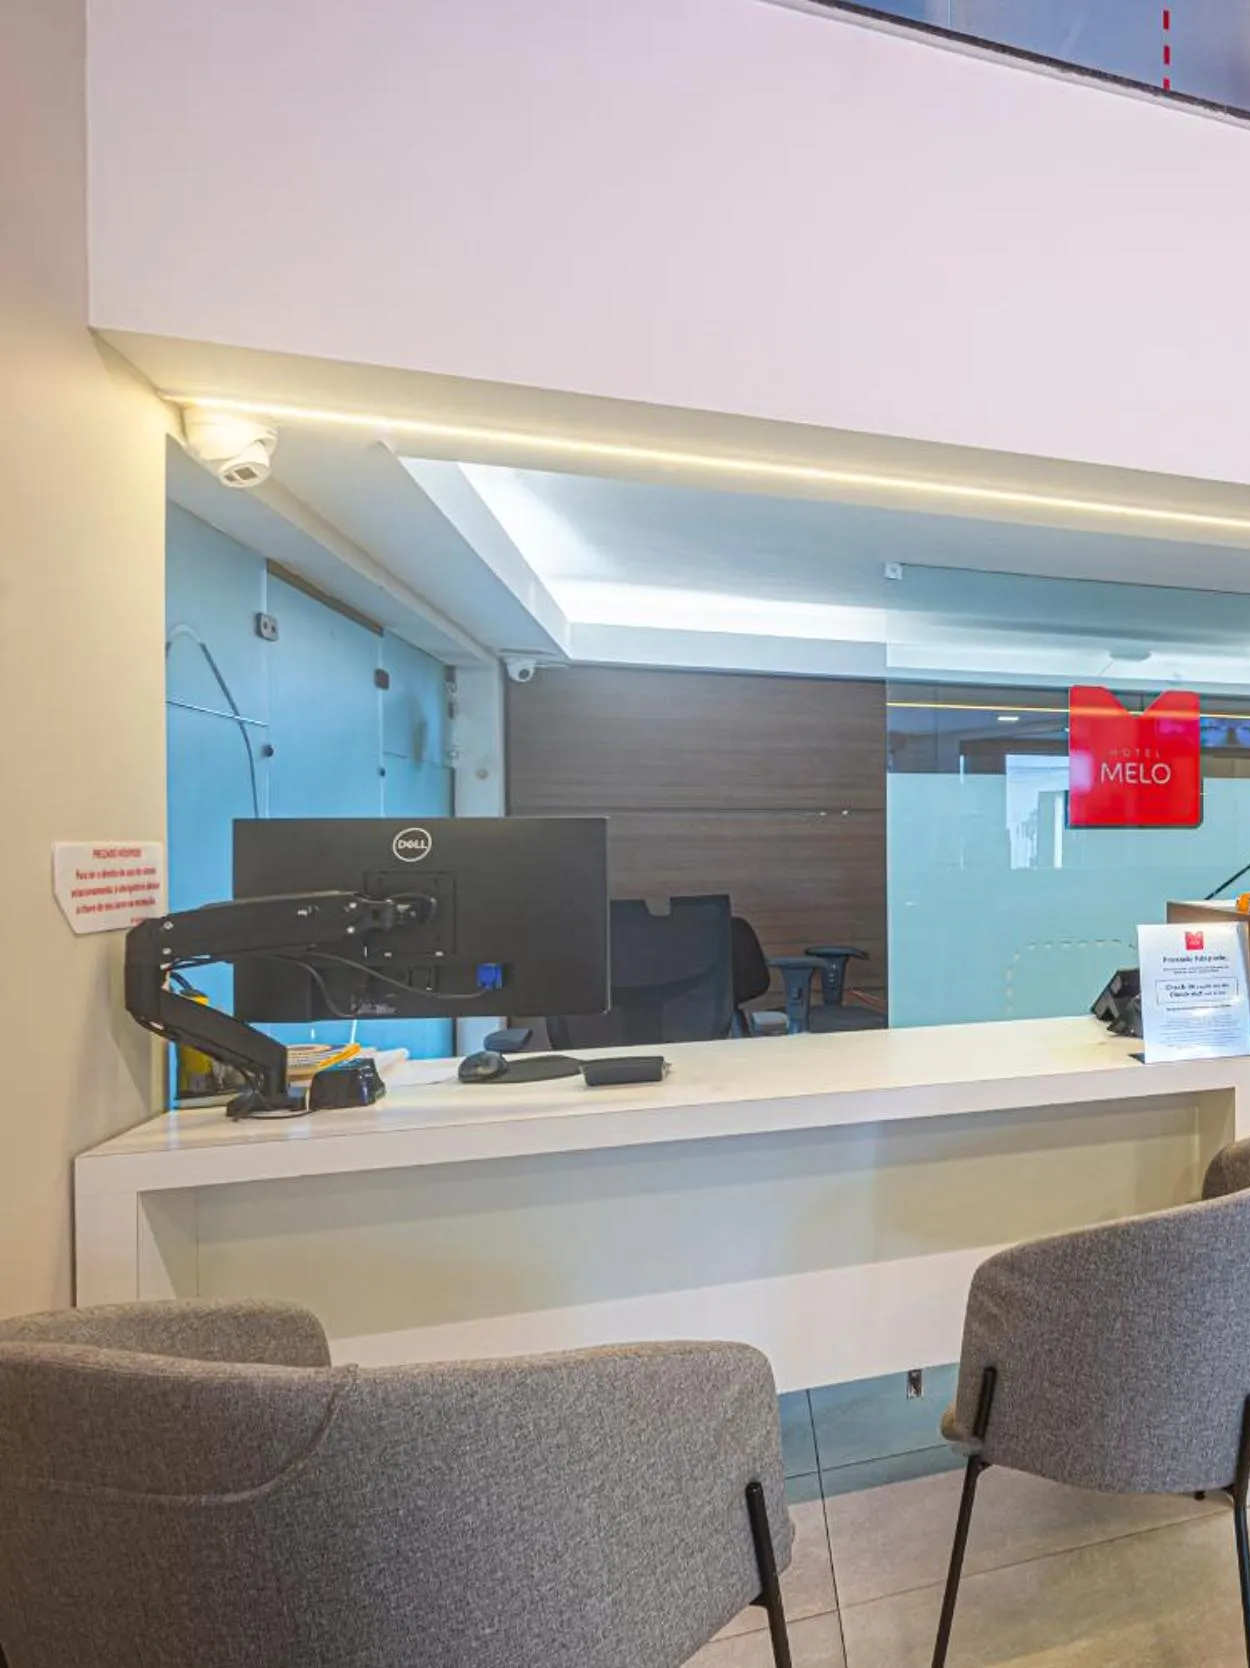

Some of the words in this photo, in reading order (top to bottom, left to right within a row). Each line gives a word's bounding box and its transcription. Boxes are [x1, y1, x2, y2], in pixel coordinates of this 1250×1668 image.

[1108, 747, 1161, 758] HOTEL
[1100, 761, 1172, 785] MELO
[397, 839, 428, 849] DELL
